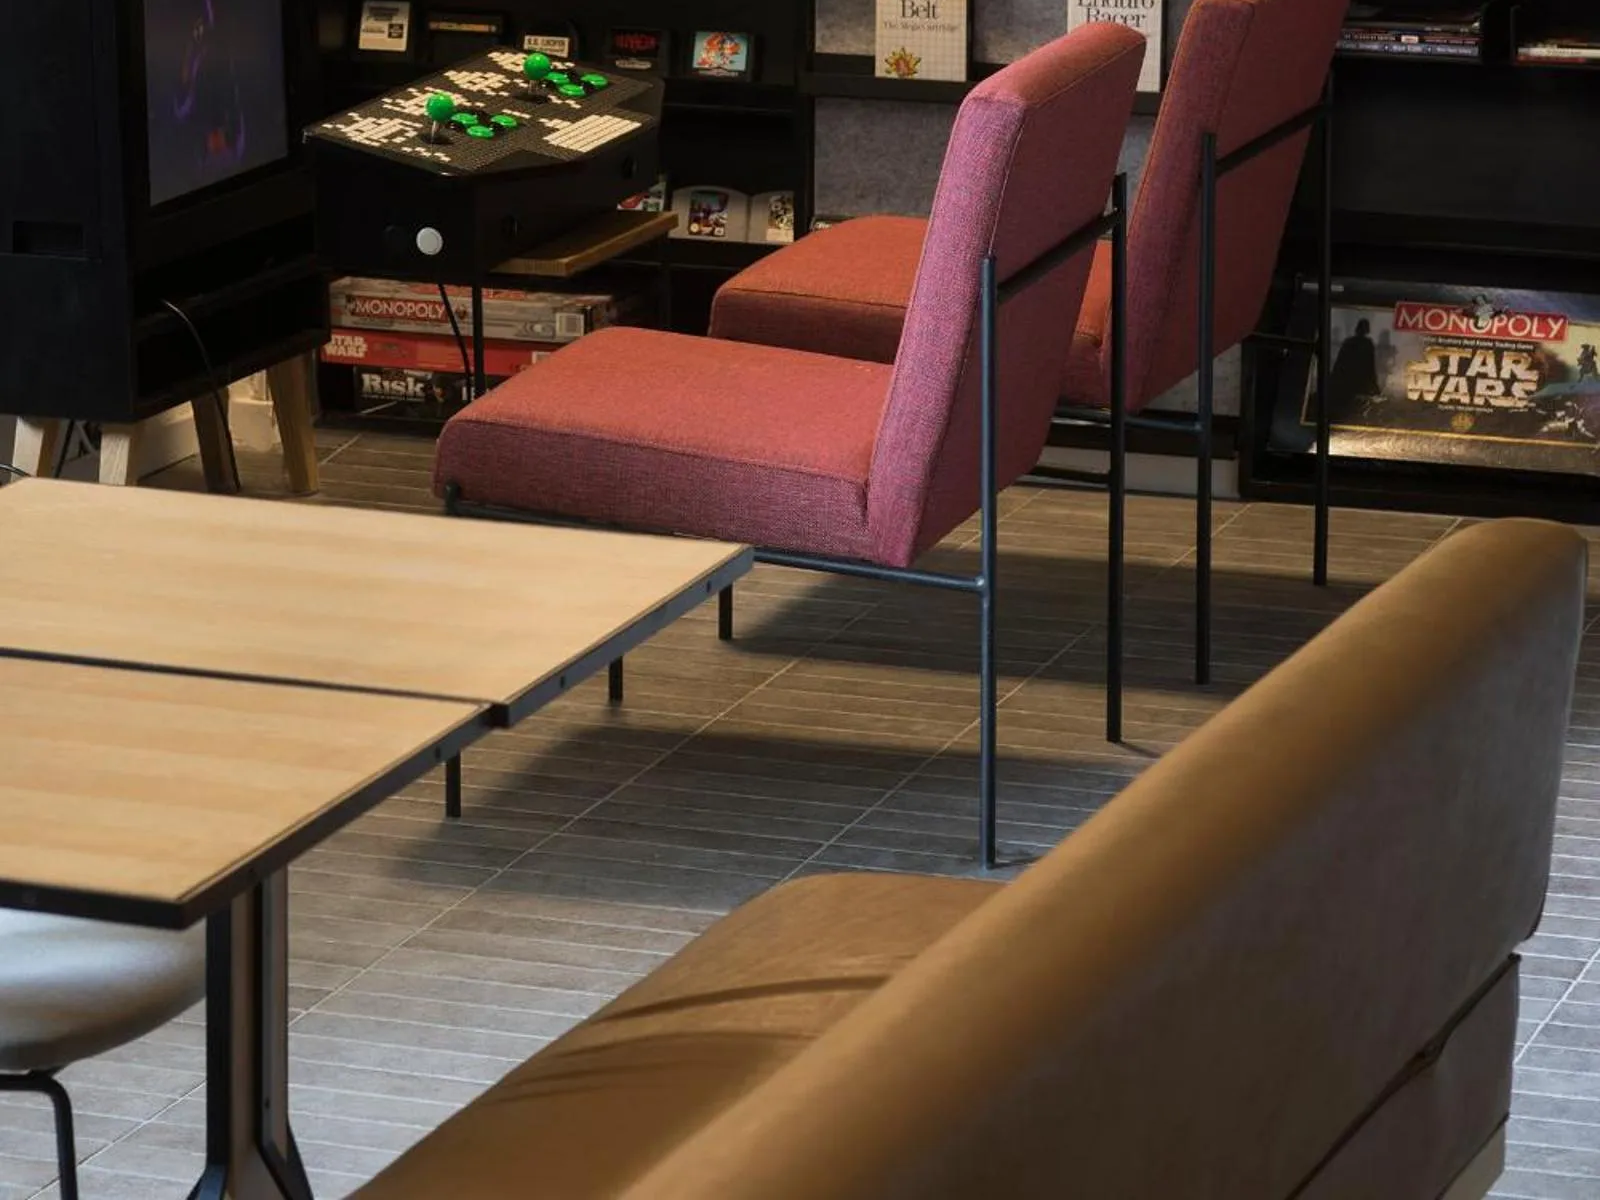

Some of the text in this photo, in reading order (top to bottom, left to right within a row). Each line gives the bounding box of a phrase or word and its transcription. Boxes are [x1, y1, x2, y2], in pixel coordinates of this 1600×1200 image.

[900, 0, 939, 19] Belt
[1086, 8, 1147, 28] Racer
[354, 300, 446, 320] MONOPOLY
[1396, 307, 1565, 340] MONOPOLY
[326, 334, 367, 346] STAR
[325, 345, 368, 358] WARS
[1404, 345, 1539, 382] STAR
[1406, 373, 1538, 408] WARS
